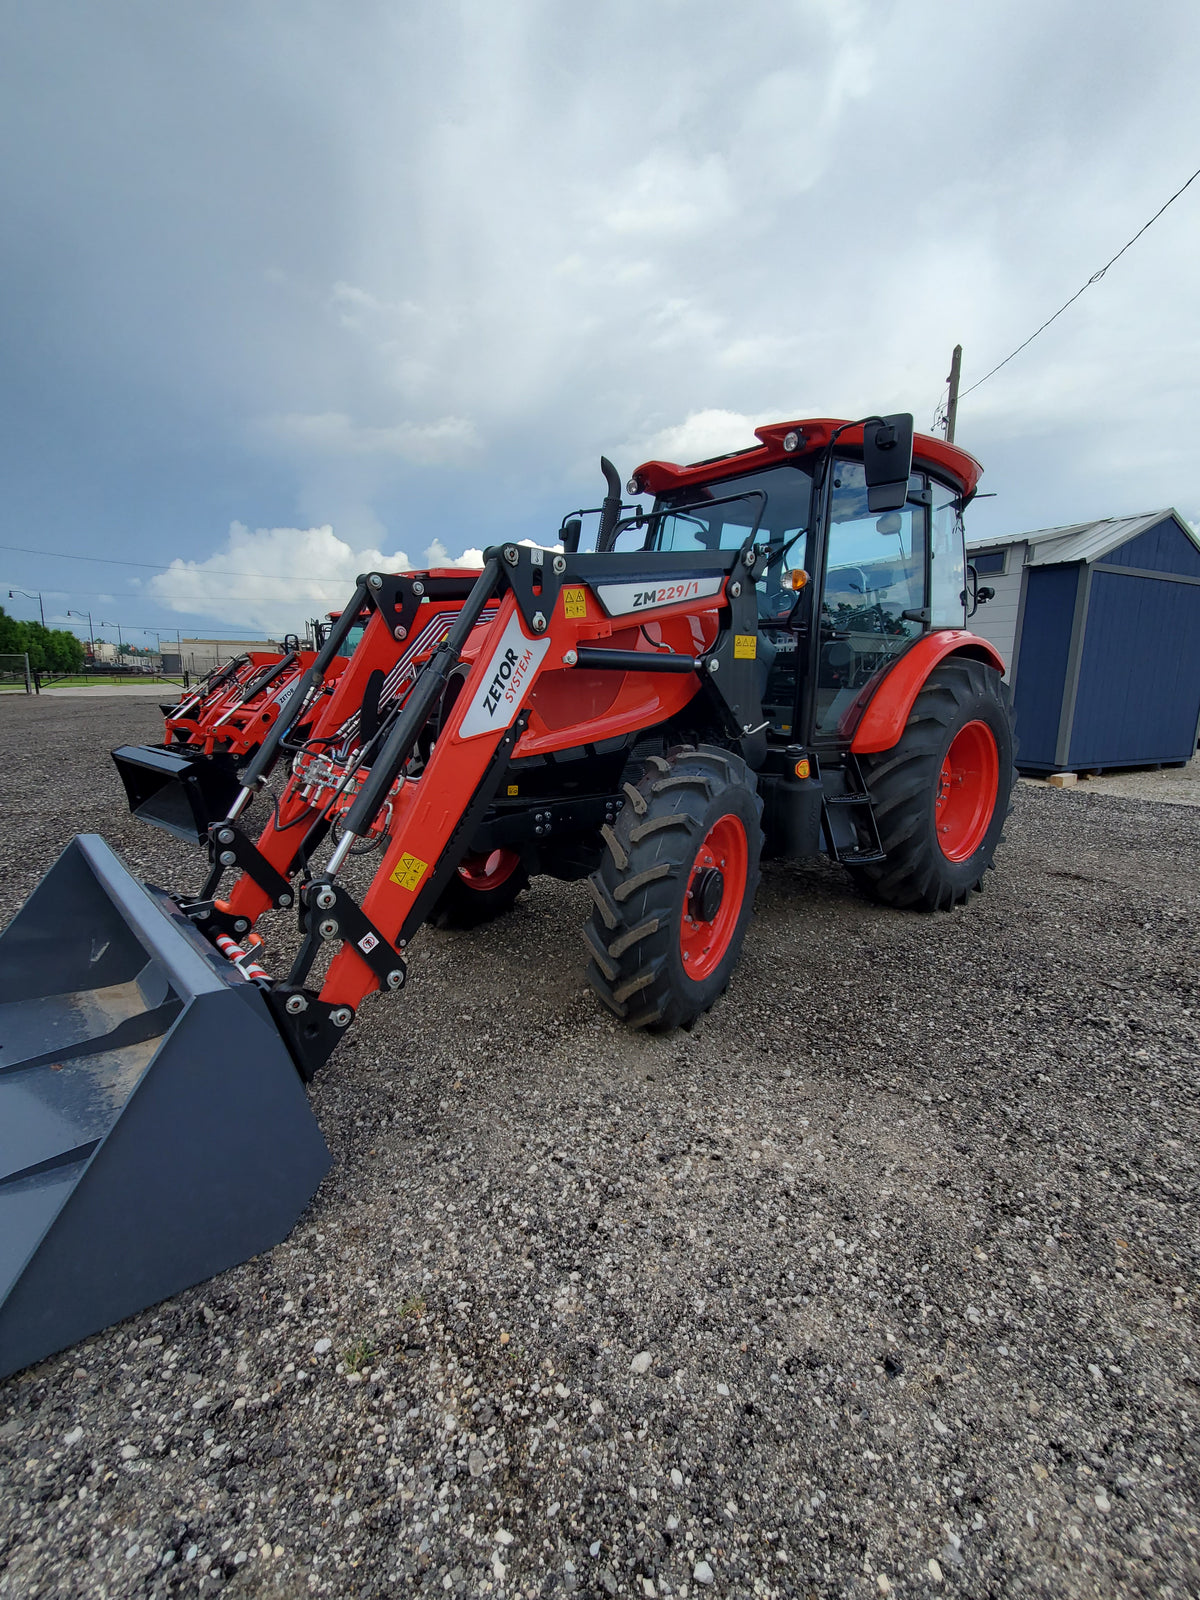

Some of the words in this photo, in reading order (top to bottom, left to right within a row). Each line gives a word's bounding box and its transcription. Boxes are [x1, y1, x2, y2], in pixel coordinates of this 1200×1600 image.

[633, 582, 699, 607] ZM229/1
[482, 648, 519, 717] ZETOR
[505, 649, 533, 703] SYSTEM
[279, 688, 295, 704] ZETOR
